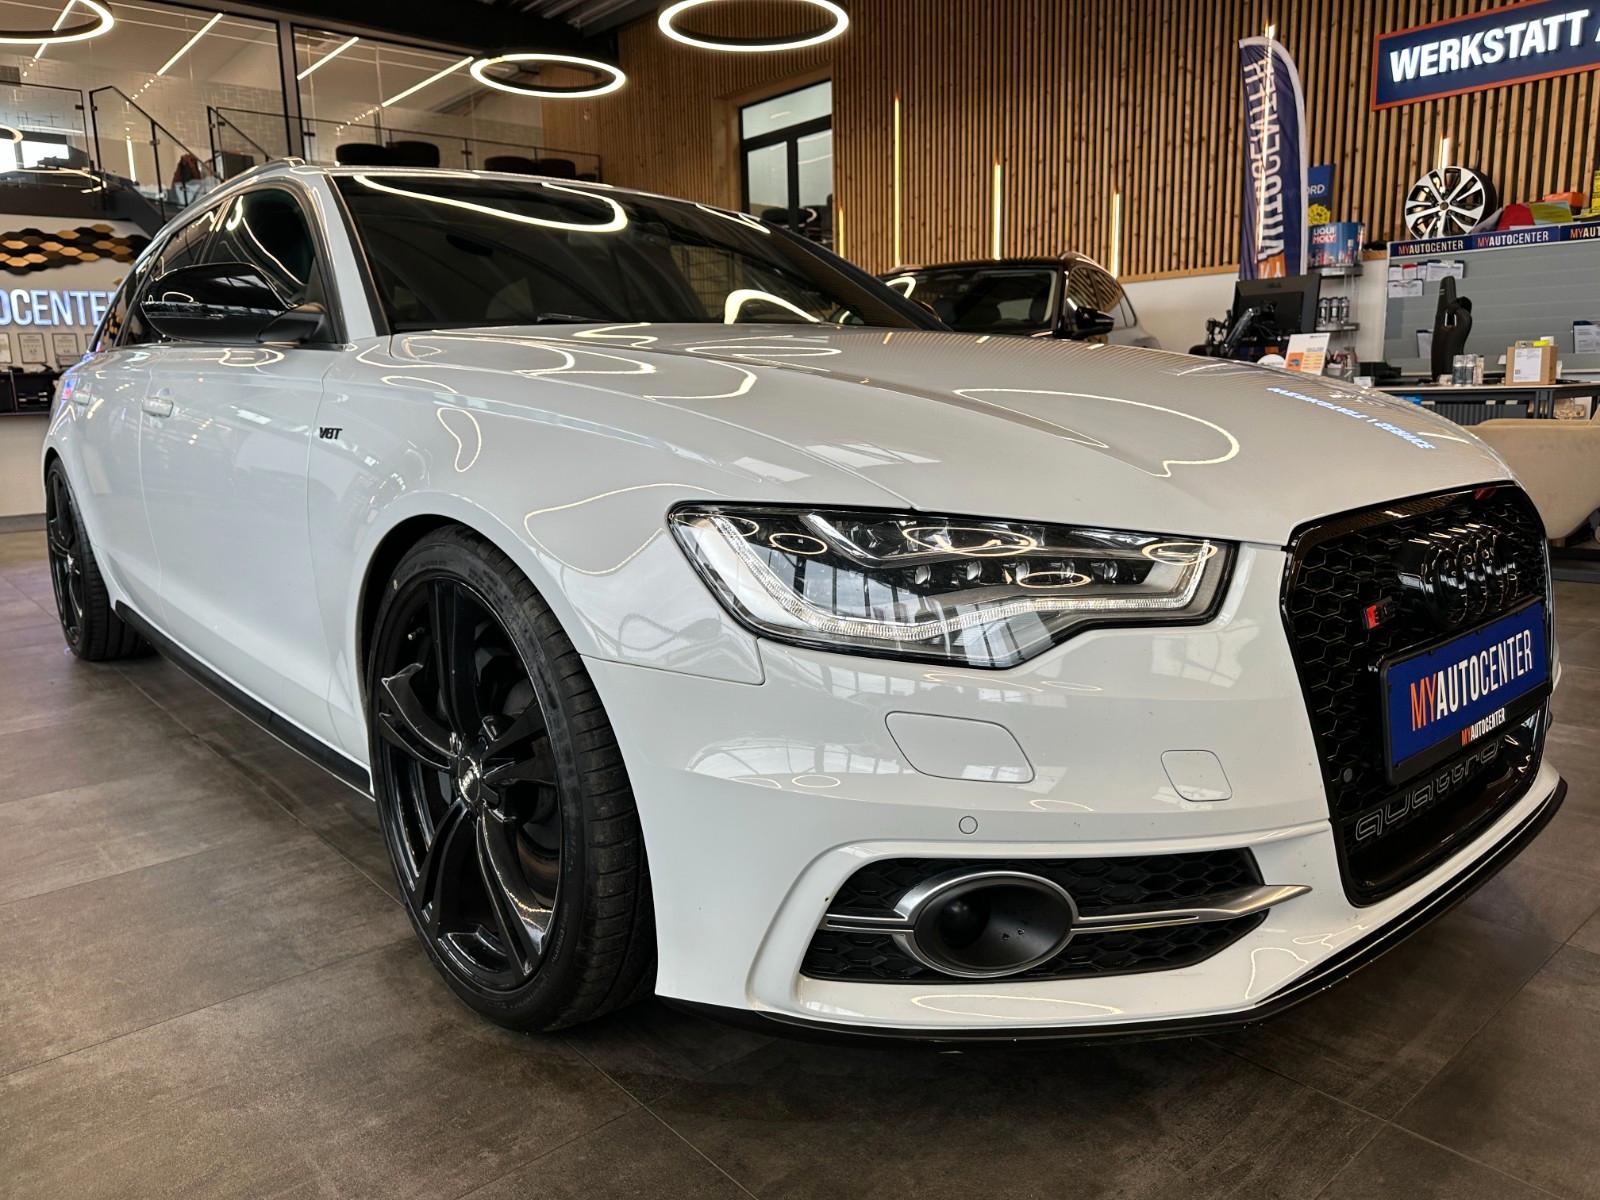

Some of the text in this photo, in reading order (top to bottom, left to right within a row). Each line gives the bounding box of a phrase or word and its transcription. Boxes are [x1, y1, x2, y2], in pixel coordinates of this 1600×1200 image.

[1390, 9, 1590, 83] WERKSTATT
[1398, 239, 1464, 256] MYAUTOCENTER
[1477, 230, 1549, 247] MYAUTOCENTER
[0, 289, 116, 326] OCENTE
[319, 426, 343, 439] V8T
[1410, 629, 1533, 732] MYAUTOCENTER
[1461, 707, 1506, 746] MYAUTOCENTER
[1355, 740, 1499, 841] quattro
